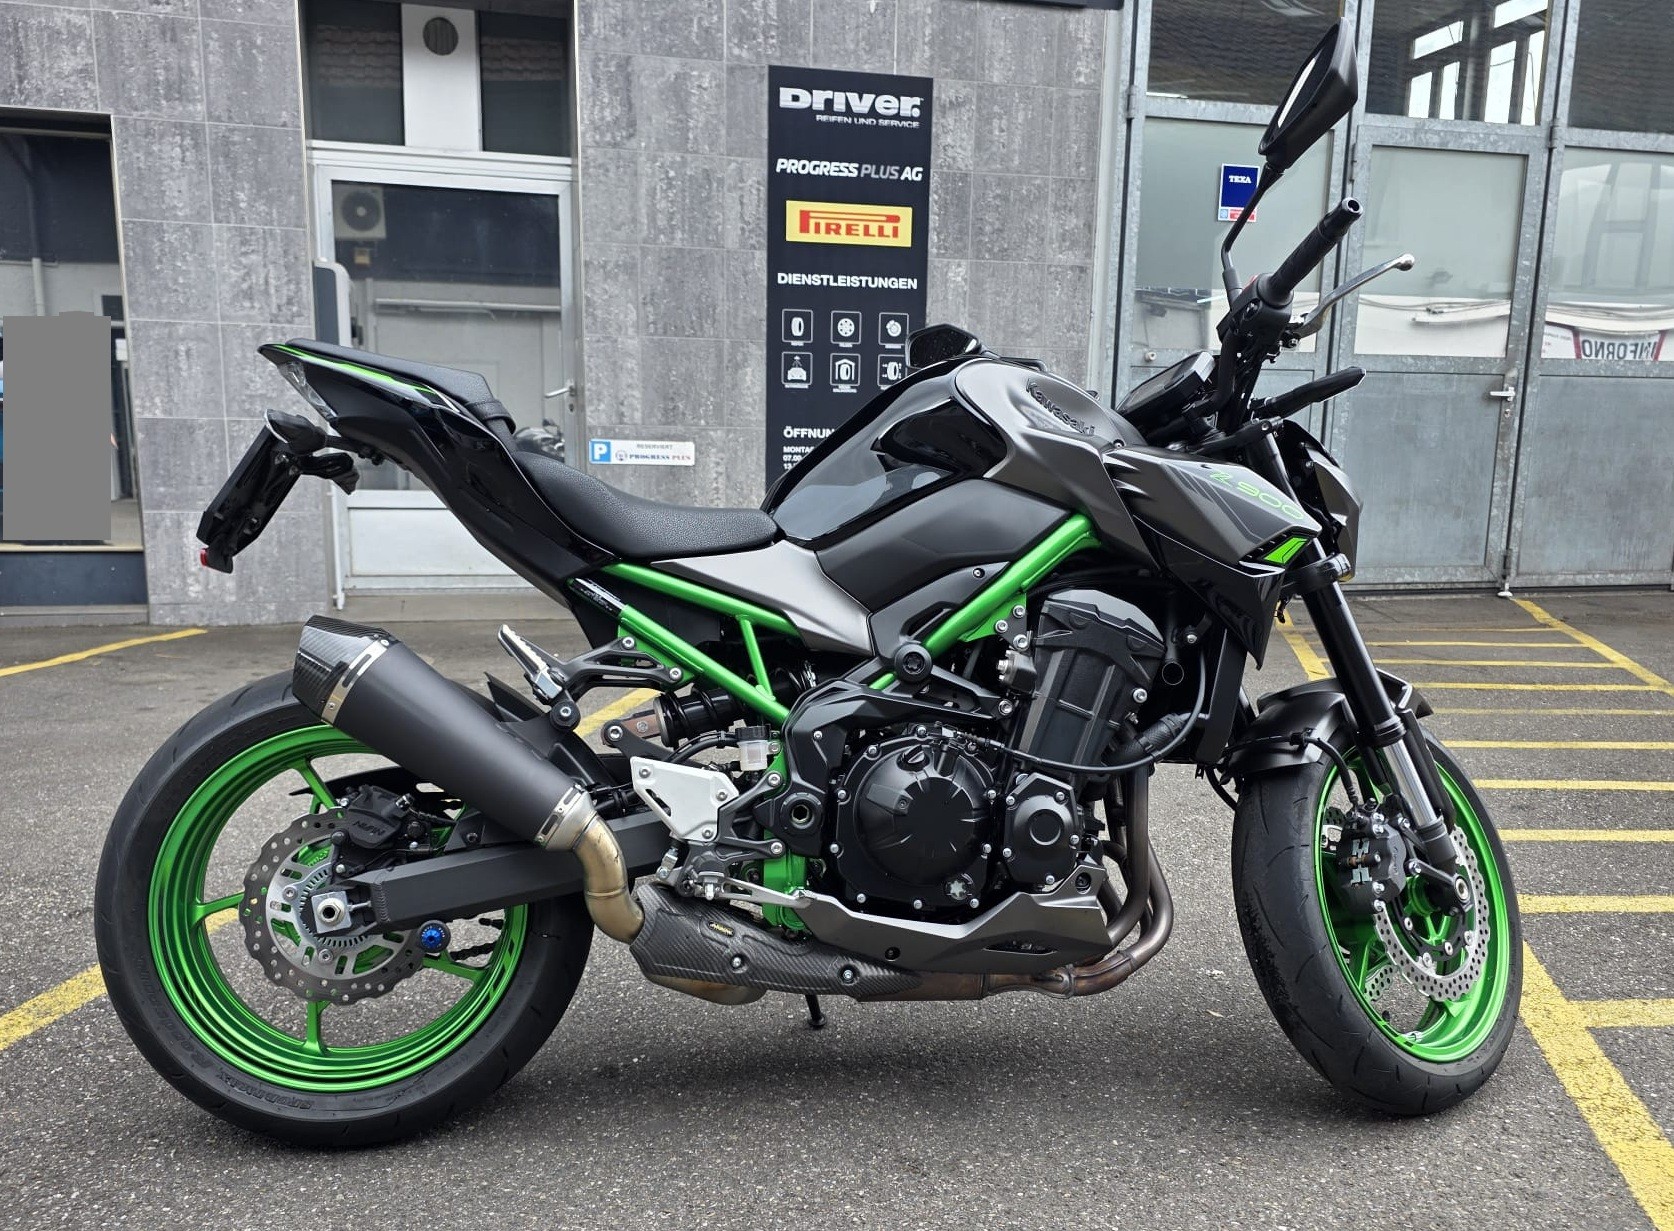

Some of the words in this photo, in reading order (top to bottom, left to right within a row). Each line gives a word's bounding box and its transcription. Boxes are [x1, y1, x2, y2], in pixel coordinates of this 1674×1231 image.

[816, 114, 852, 125] REIFEN
[854, 117, 877, 126] UND
[878, 119, 920, 129] SERVICE
[775, 158, 859, 178] PROGRESS
[860, 164, 900, 180] PLUS
[900, 166, 924, 182] AG
[1228, 175, 1252, 184] TEXA
[799, 209, 901, 239] PIRELLI
[777, 272, 918, 290] DIENSTLEISTUNGEN
[1026, 379, 1095, 436] Kawasaki
[593, 443, 608, 460] P
